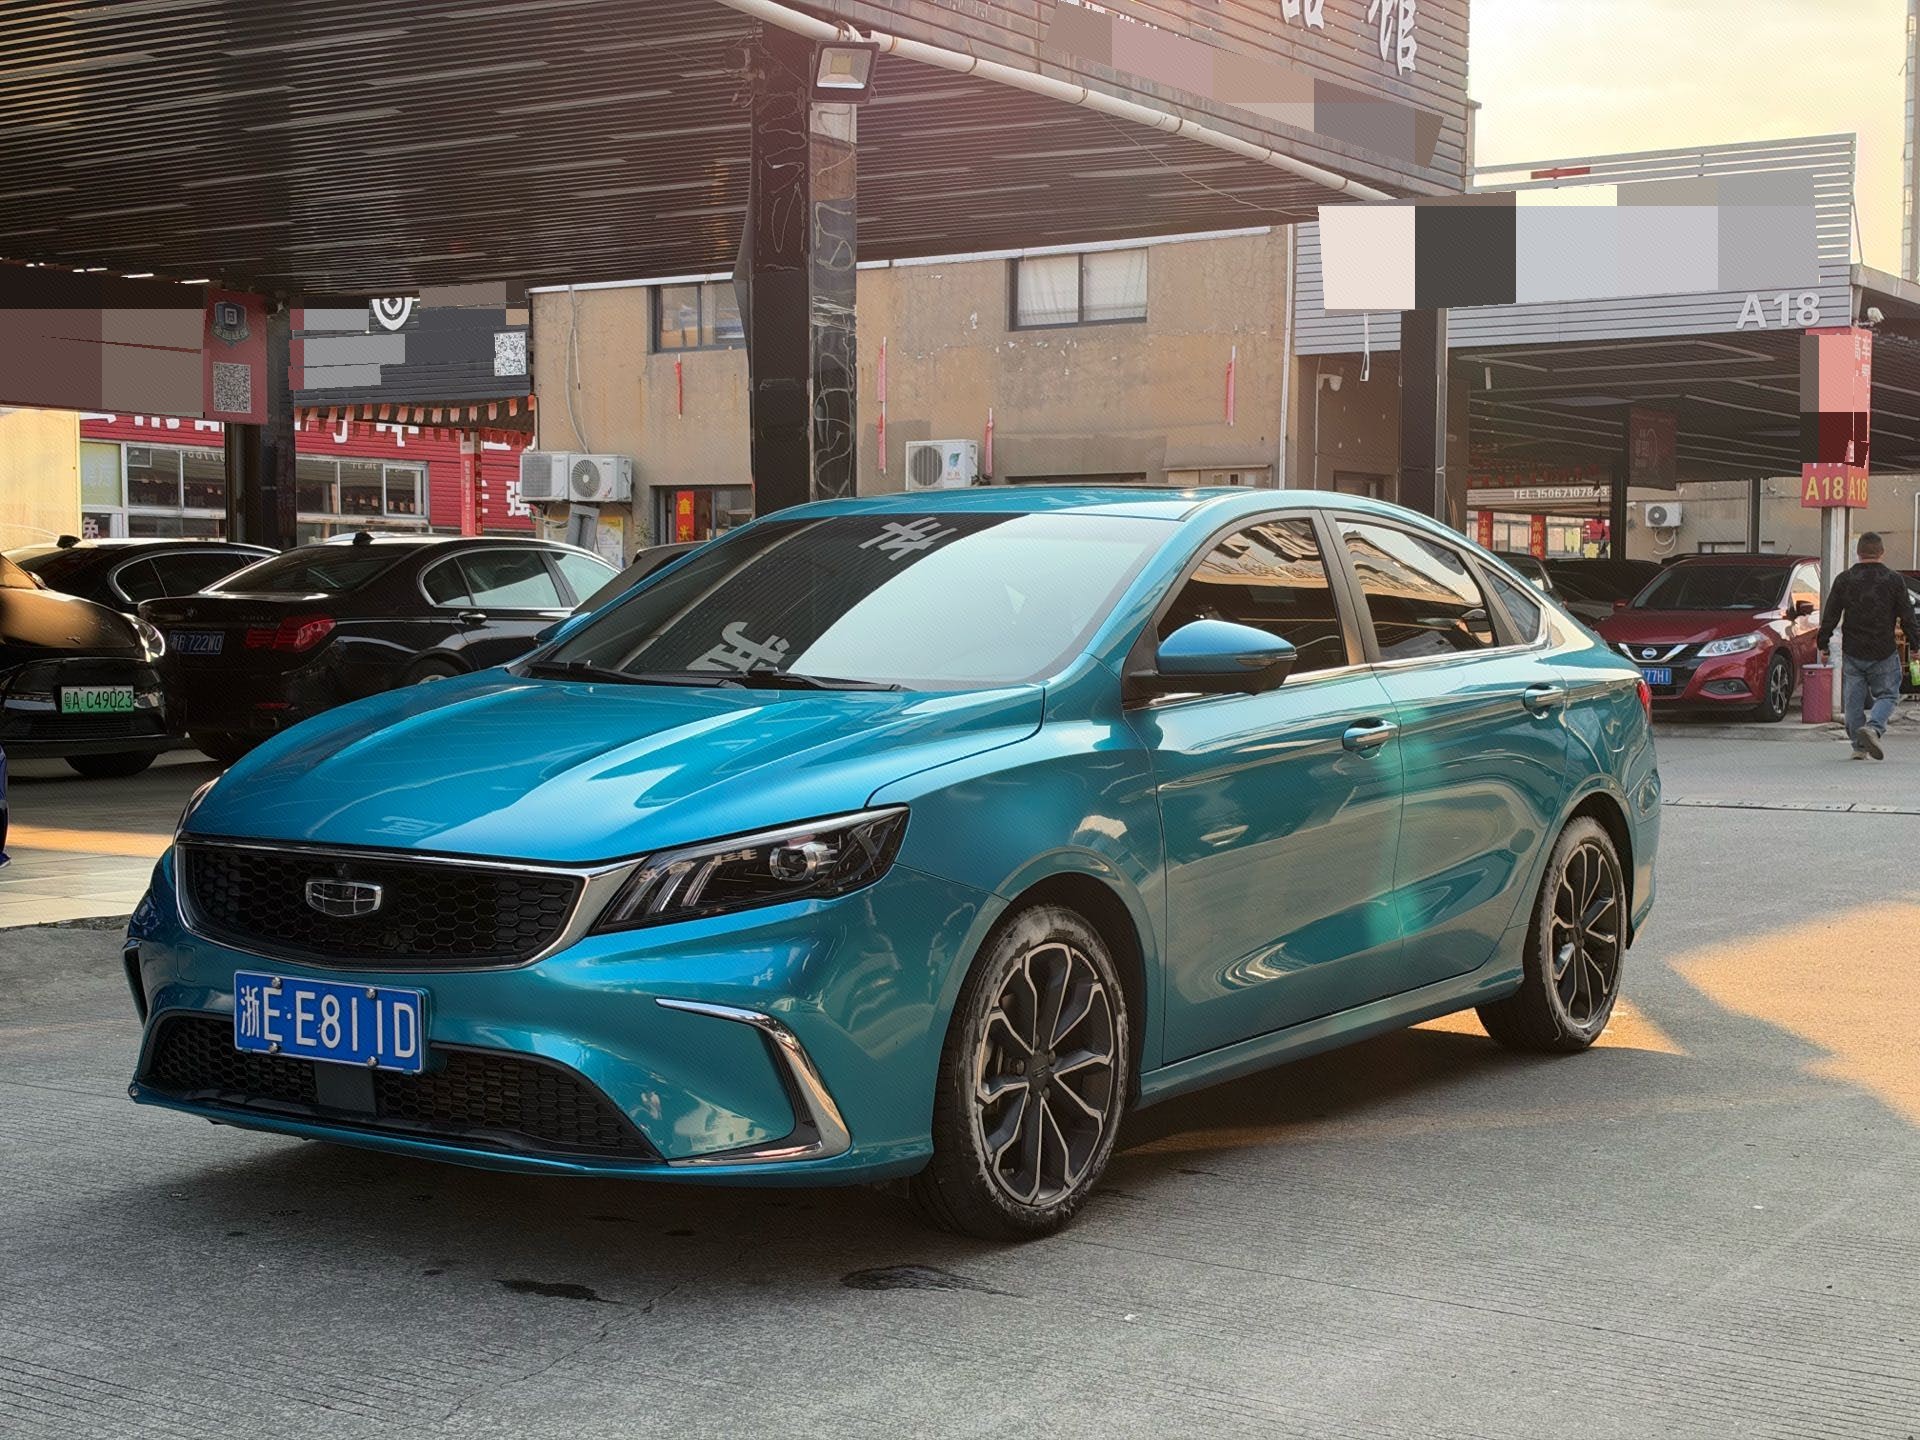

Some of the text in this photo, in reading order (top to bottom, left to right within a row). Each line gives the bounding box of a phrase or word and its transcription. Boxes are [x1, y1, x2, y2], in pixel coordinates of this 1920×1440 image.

[1736, 292, 1820, 330] A18
[1805, 475, 1844, 501] A18
[1848, 475, 1868, 502] A18
[1641, 669, 1669, 683] 77H1
